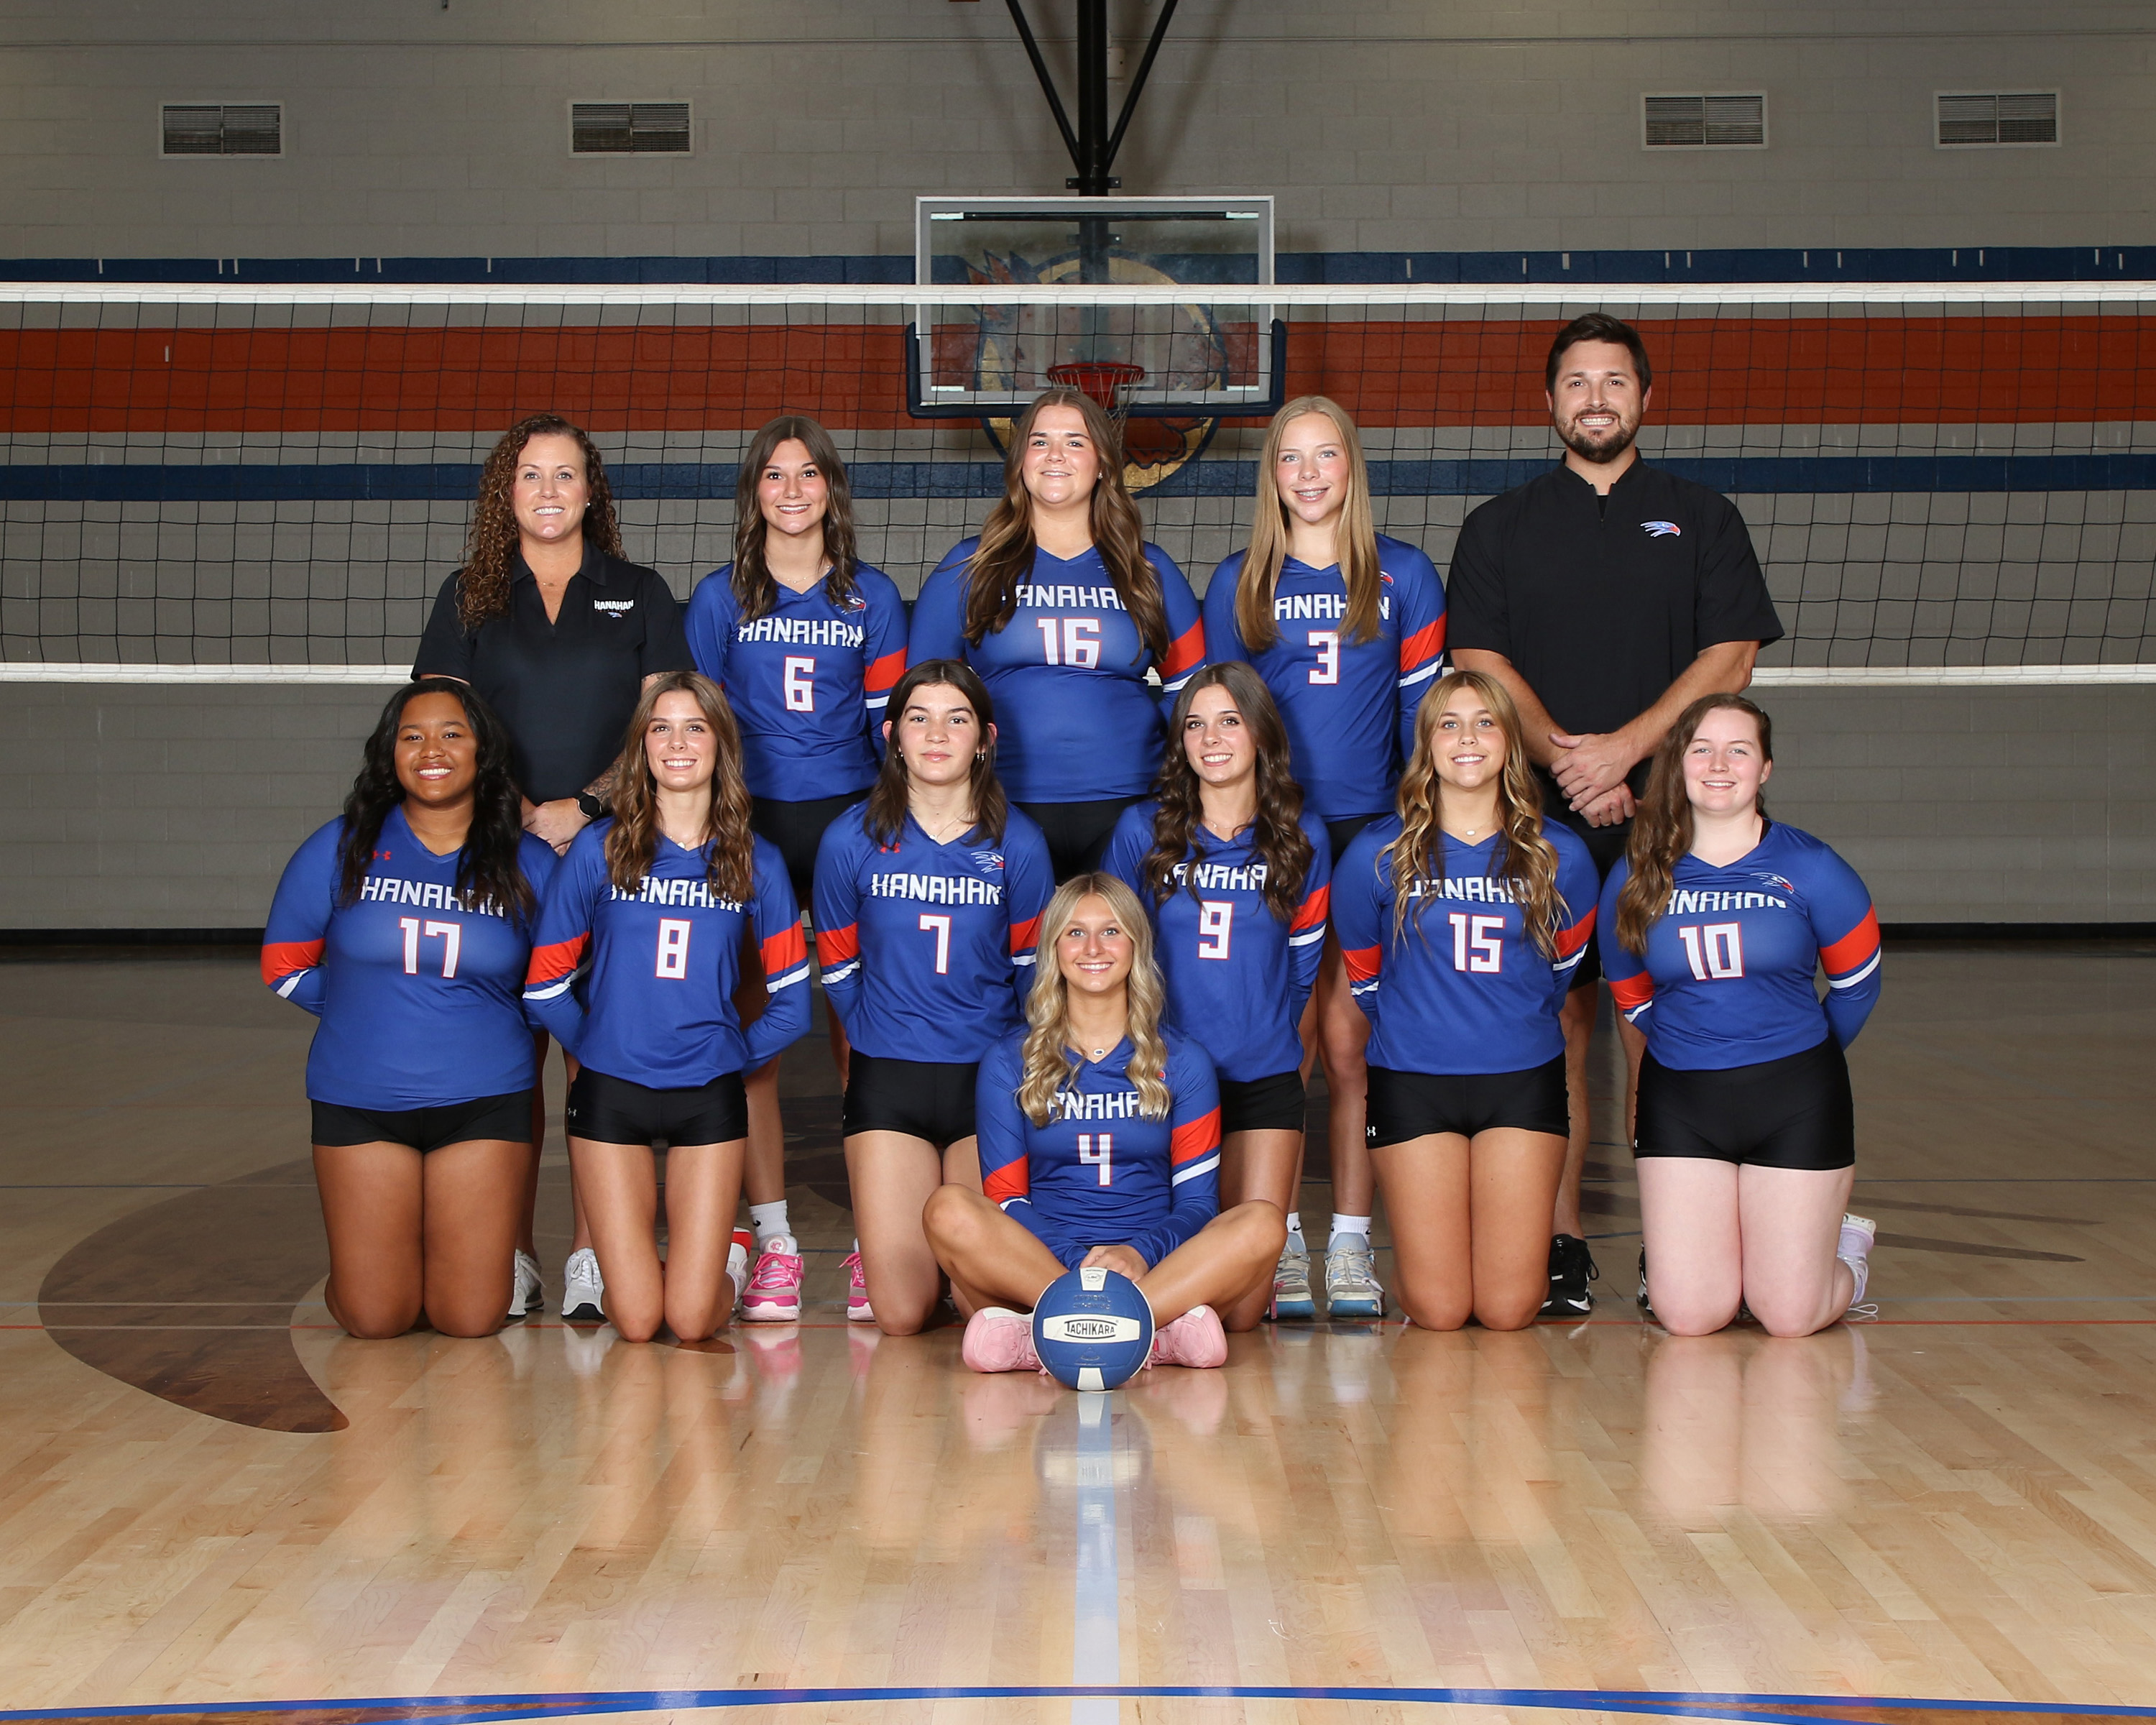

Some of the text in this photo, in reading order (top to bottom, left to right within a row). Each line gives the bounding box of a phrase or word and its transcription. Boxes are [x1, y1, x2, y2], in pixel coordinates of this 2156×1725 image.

[594, 599, 634, 610] HANAHAN
[1002, 584, 1128, 611] ANAHA
[738, 617, 864, 648] HANAHAN
[1036, 617, 1102, 670] 16
[1307, 630, 1340, 685] 3
[784, 655, 816, 713] 6
[871, 873, 1003, 906] HANAHAN
[399, 916, 462, 979] 17
[655, 917, 692, 980] 8
[918, 913, 952, 975] 7
[1197, 900, 1235, 961] 9
[1448, 912, 1506, 973] 15
[1678, 921, 1746, 982] 10
[1077, 1132, 1113, 1187] 4
[1064, 1320, 1115, 1336] TACHIKARA
